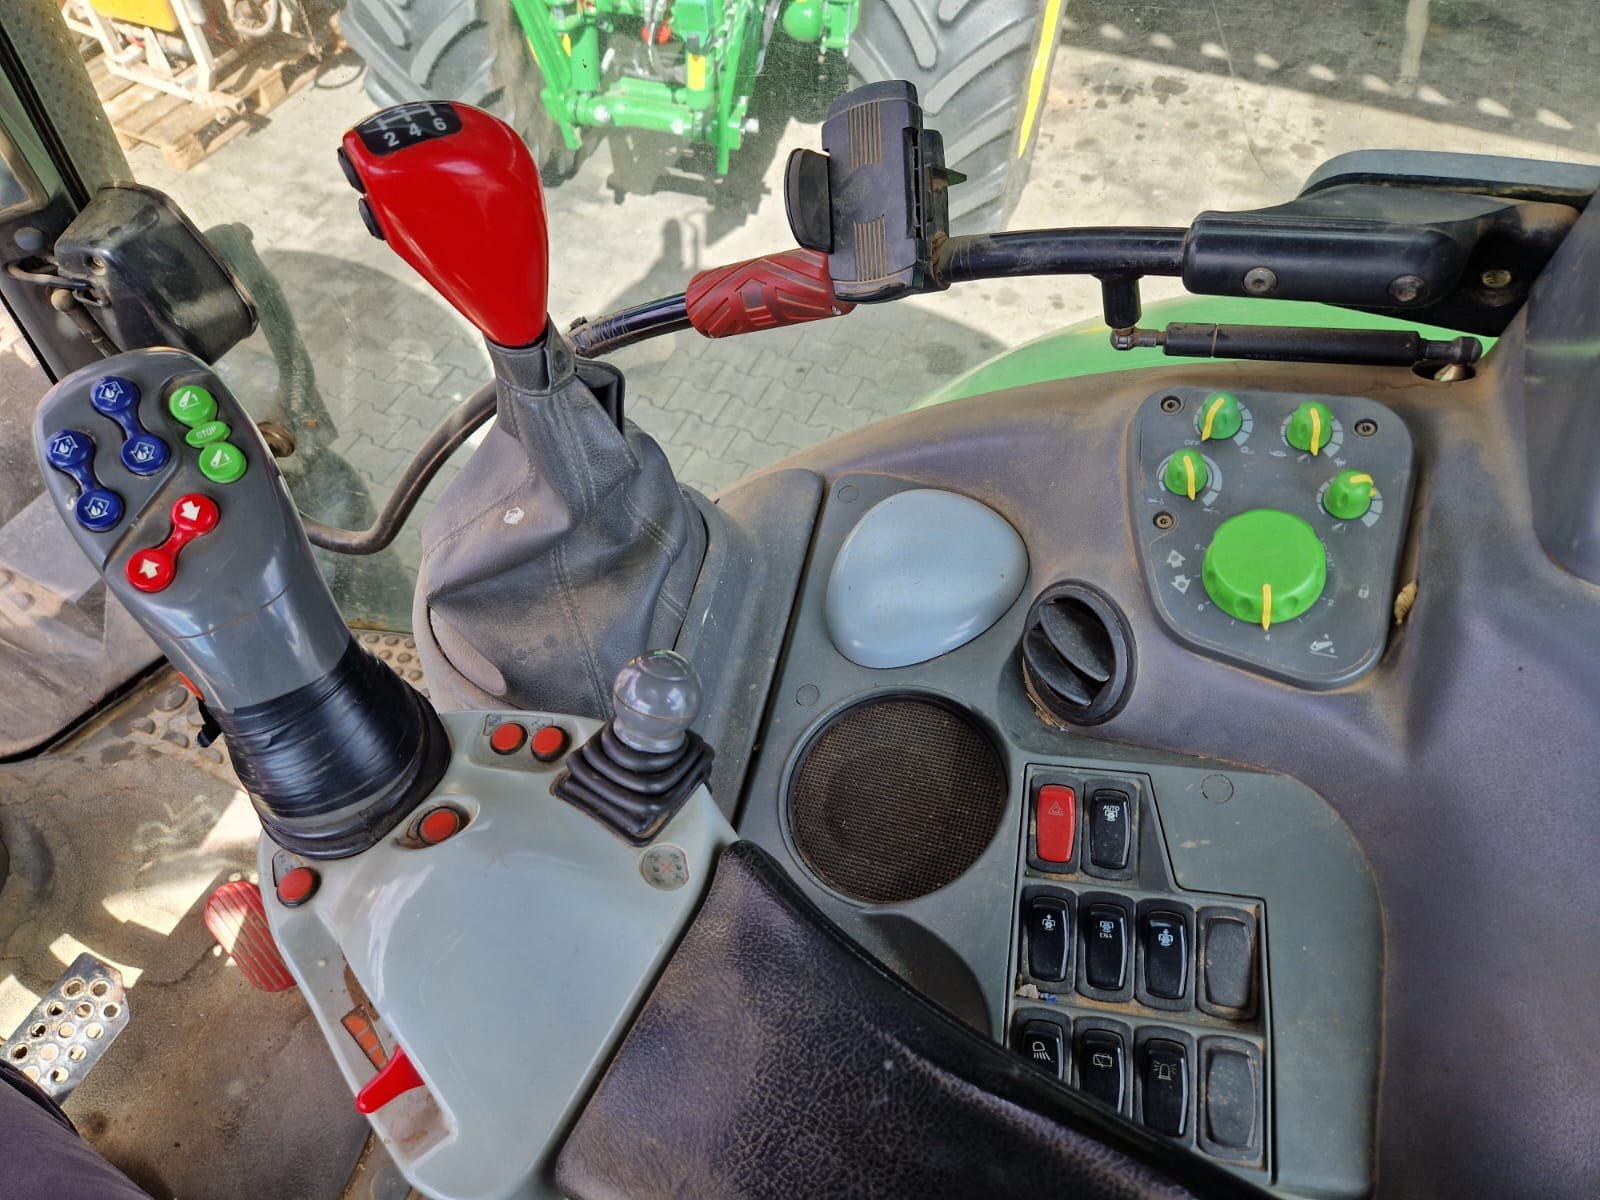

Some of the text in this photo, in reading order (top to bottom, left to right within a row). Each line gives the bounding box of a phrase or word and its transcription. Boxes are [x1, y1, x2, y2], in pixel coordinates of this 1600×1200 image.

[384, 117, 447, 147] 2 4 6
[196, 425, 217, 440] STOP
